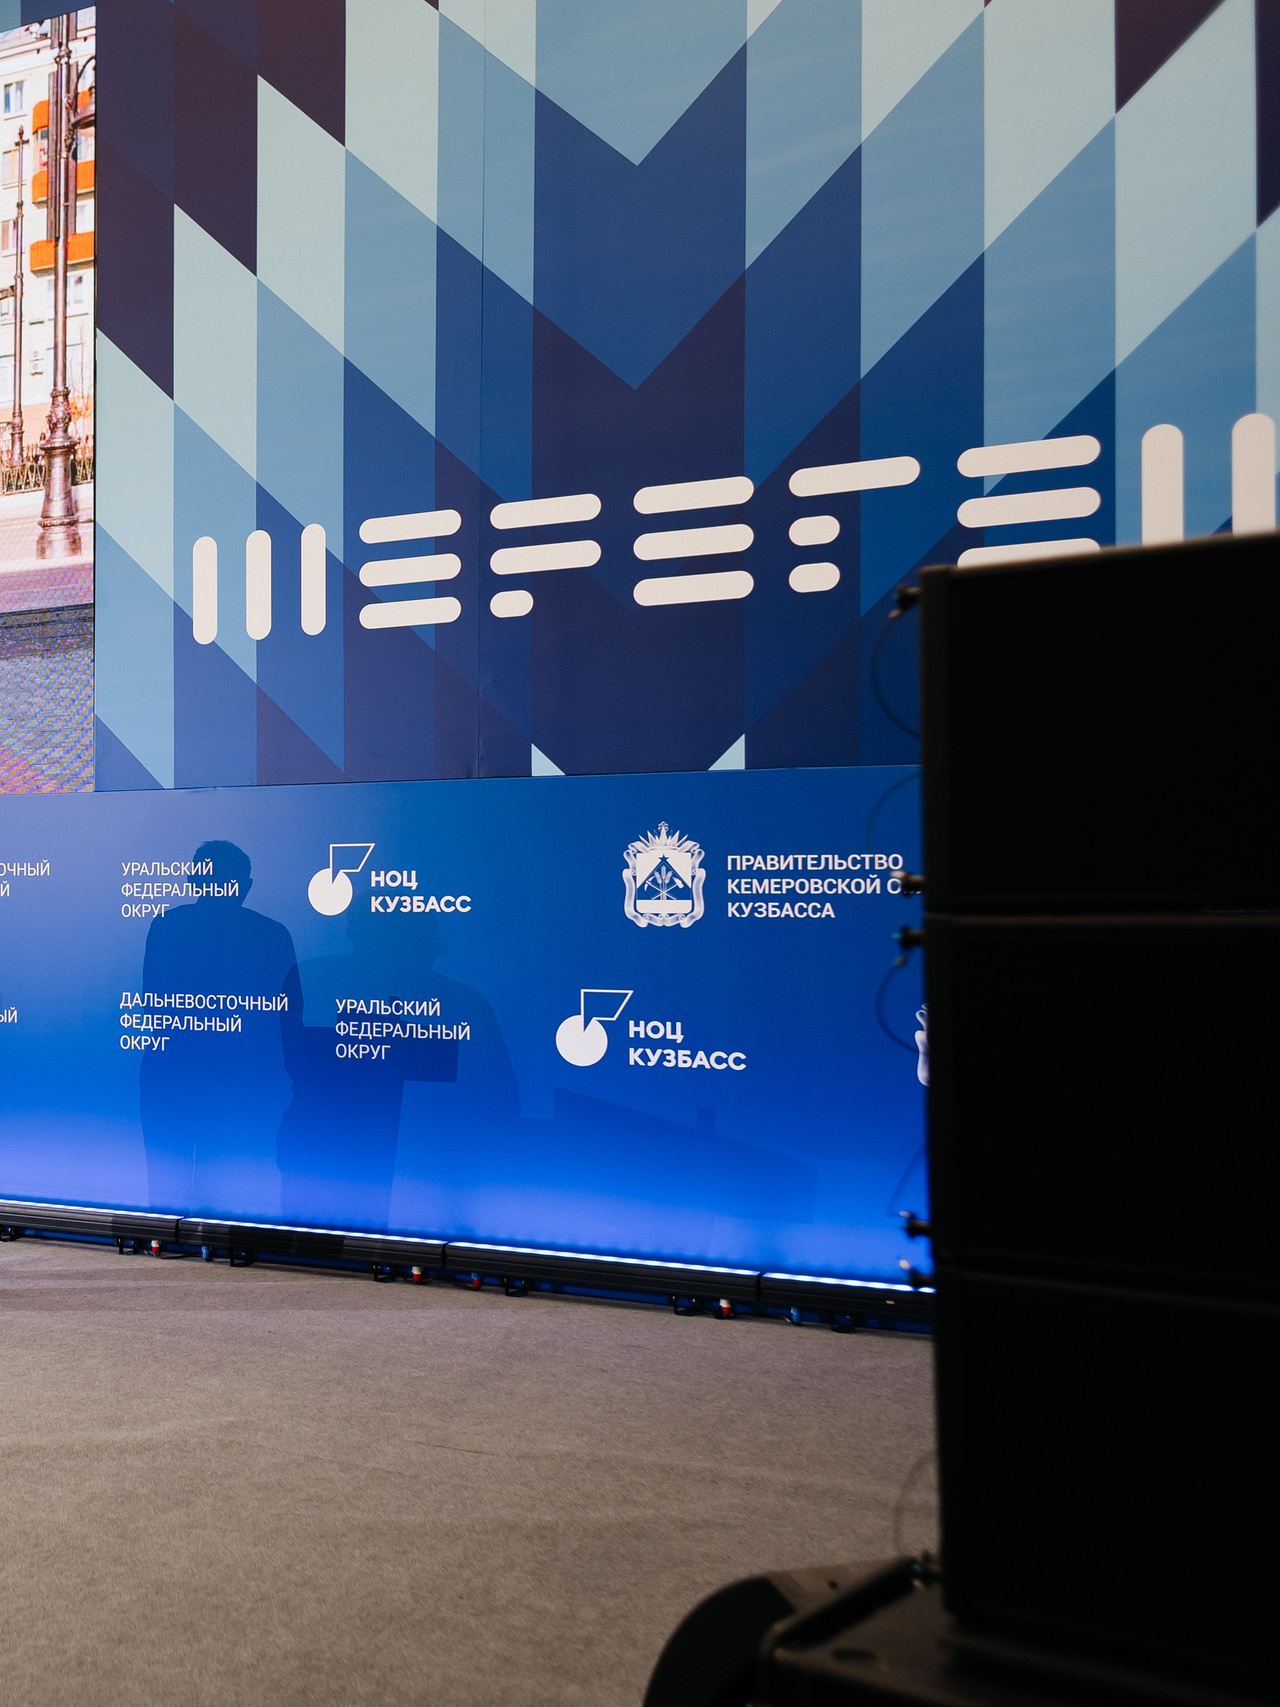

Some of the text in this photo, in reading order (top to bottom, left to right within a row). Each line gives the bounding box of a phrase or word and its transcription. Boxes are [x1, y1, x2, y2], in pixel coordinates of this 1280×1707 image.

[121, 859, 214, 876] УРАЛЬСКИЙ
[727, 854, 903, 871] ПРАВИТЕЛЬСТВО
[121, 879, 239, 900] ФЕДЕРАЛЬНЫЙ
[371, 870, 418, 890] НОЦ
[727, 873, 879, 895] КЕМЕРОВСКОЙ
[121, 903, 170, 918] ОКРУГ
[370, 896, 472, 913] КУЗБАСС
[727, 902, 836, 918] КУЗБАССА
[120, 992, 289, 1012] ДАЛЬНЕВОСТОЧНЫЙ
[335, 997, 441, 1017] УРАЛЬСКИЙ
[120, 1014, 242, 1033] ФЕДЕРАЛЬНЫЙ
[335, 1021, 471, 1041] ФЕДЕРАЛЬНЫЙ
[629, 1020, 684, 1043] НОЦ
[120, 1035, 170, 1051] ОКРУГ
[335, 1044, 391, 1060] ОКРУГ
[628, 1048, 747, 1071] КУЗБАСС
